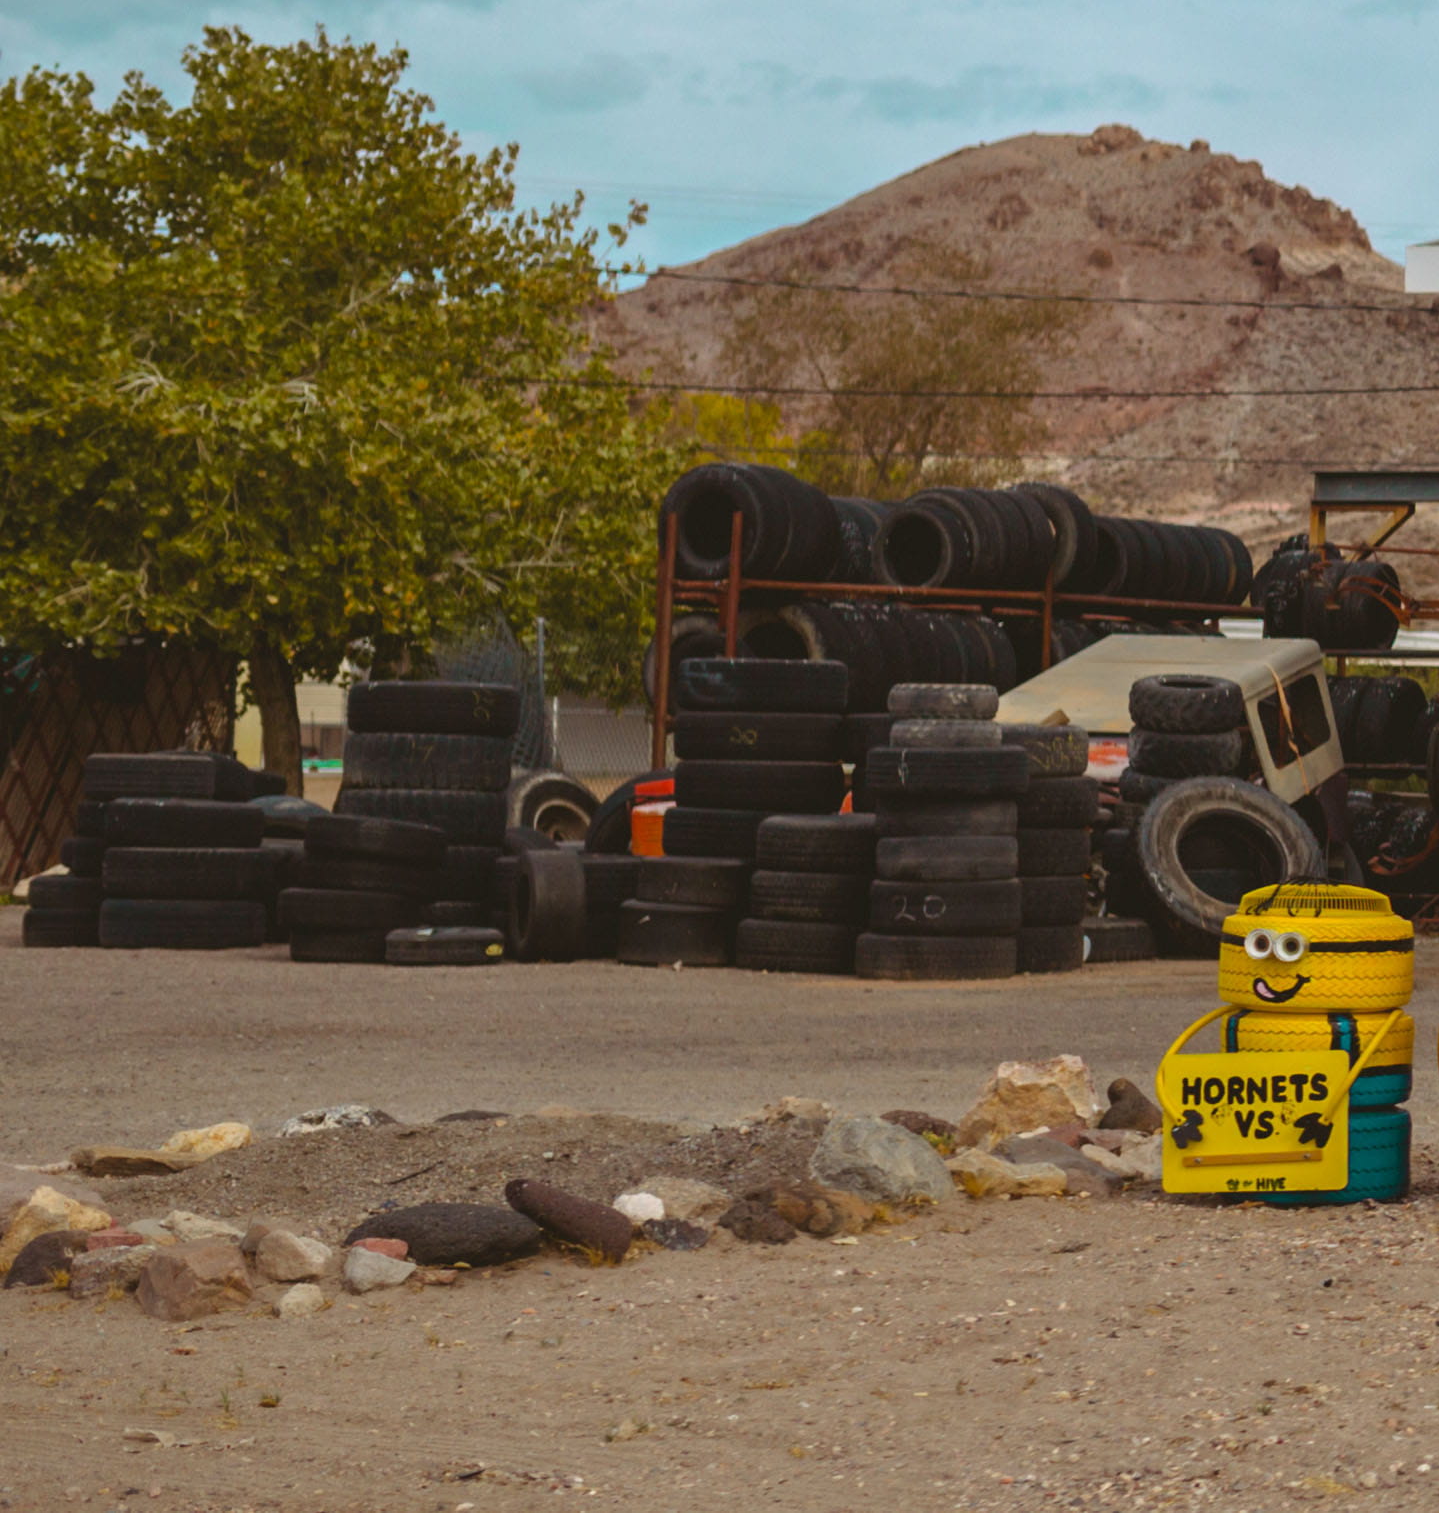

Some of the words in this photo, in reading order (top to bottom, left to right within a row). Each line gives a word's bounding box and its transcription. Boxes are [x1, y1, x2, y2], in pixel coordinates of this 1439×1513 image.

[890, 894, 948, 922] 20
[1181, 1072, 1329, 1106] HORNETS
[1255, 1177, 1287, 1192] HIVE
